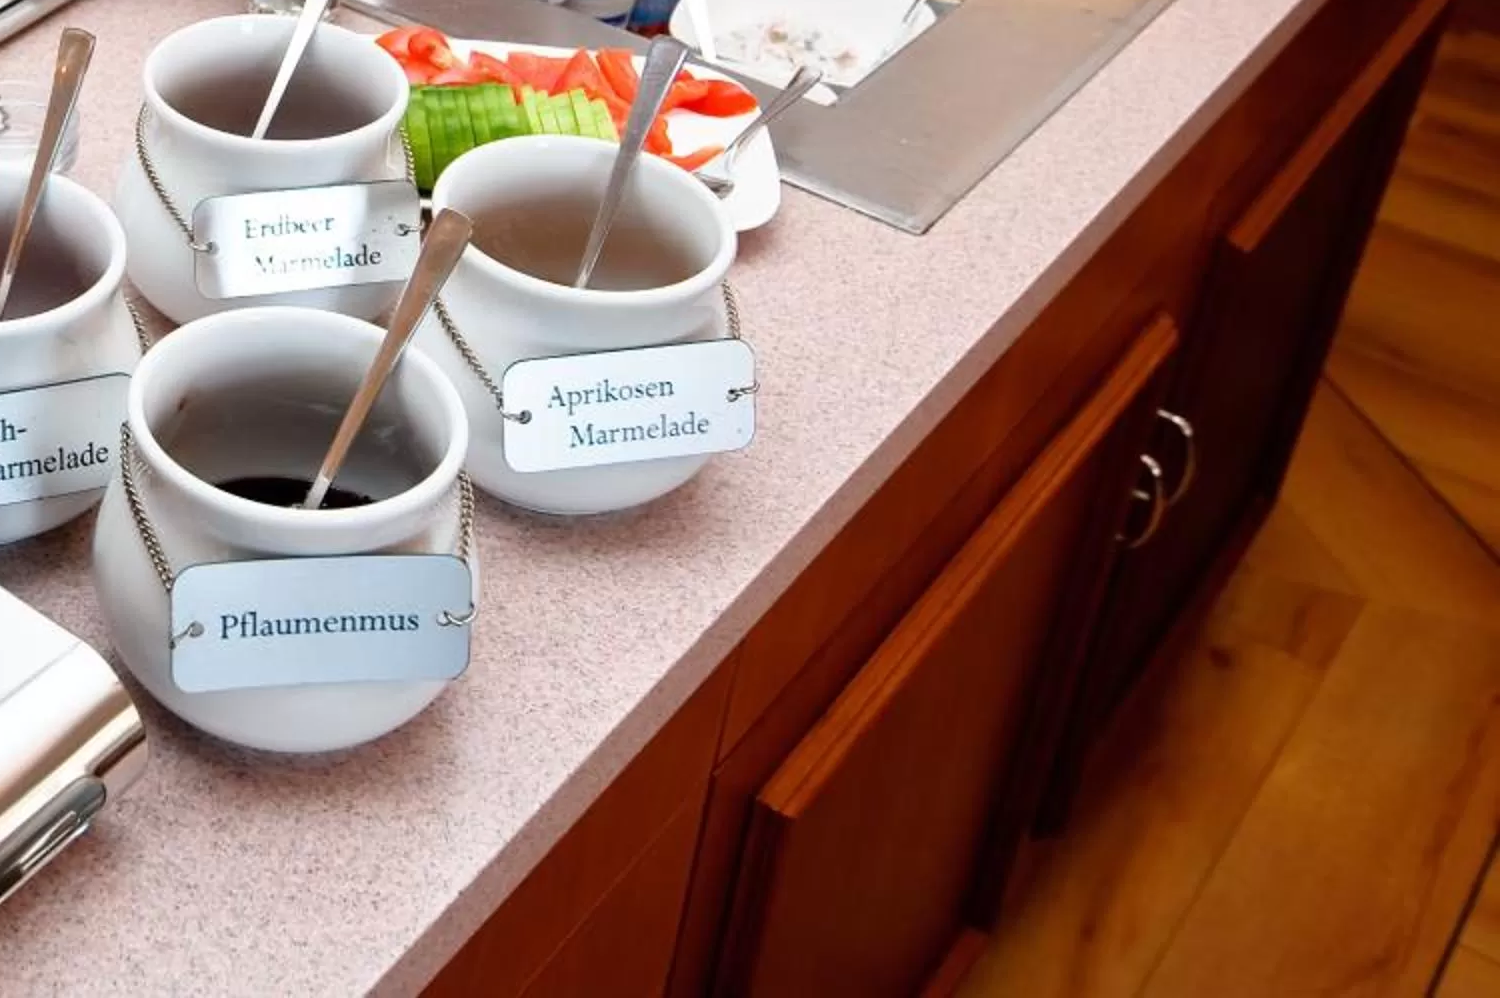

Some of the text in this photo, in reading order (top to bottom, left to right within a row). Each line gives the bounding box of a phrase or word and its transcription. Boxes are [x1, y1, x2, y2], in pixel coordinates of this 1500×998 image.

[547, 379, 675, 416] Aprikosen
[569, 411, 709, 449] Marmelade
[220, 611, 420, 640] Pflaumenmus
